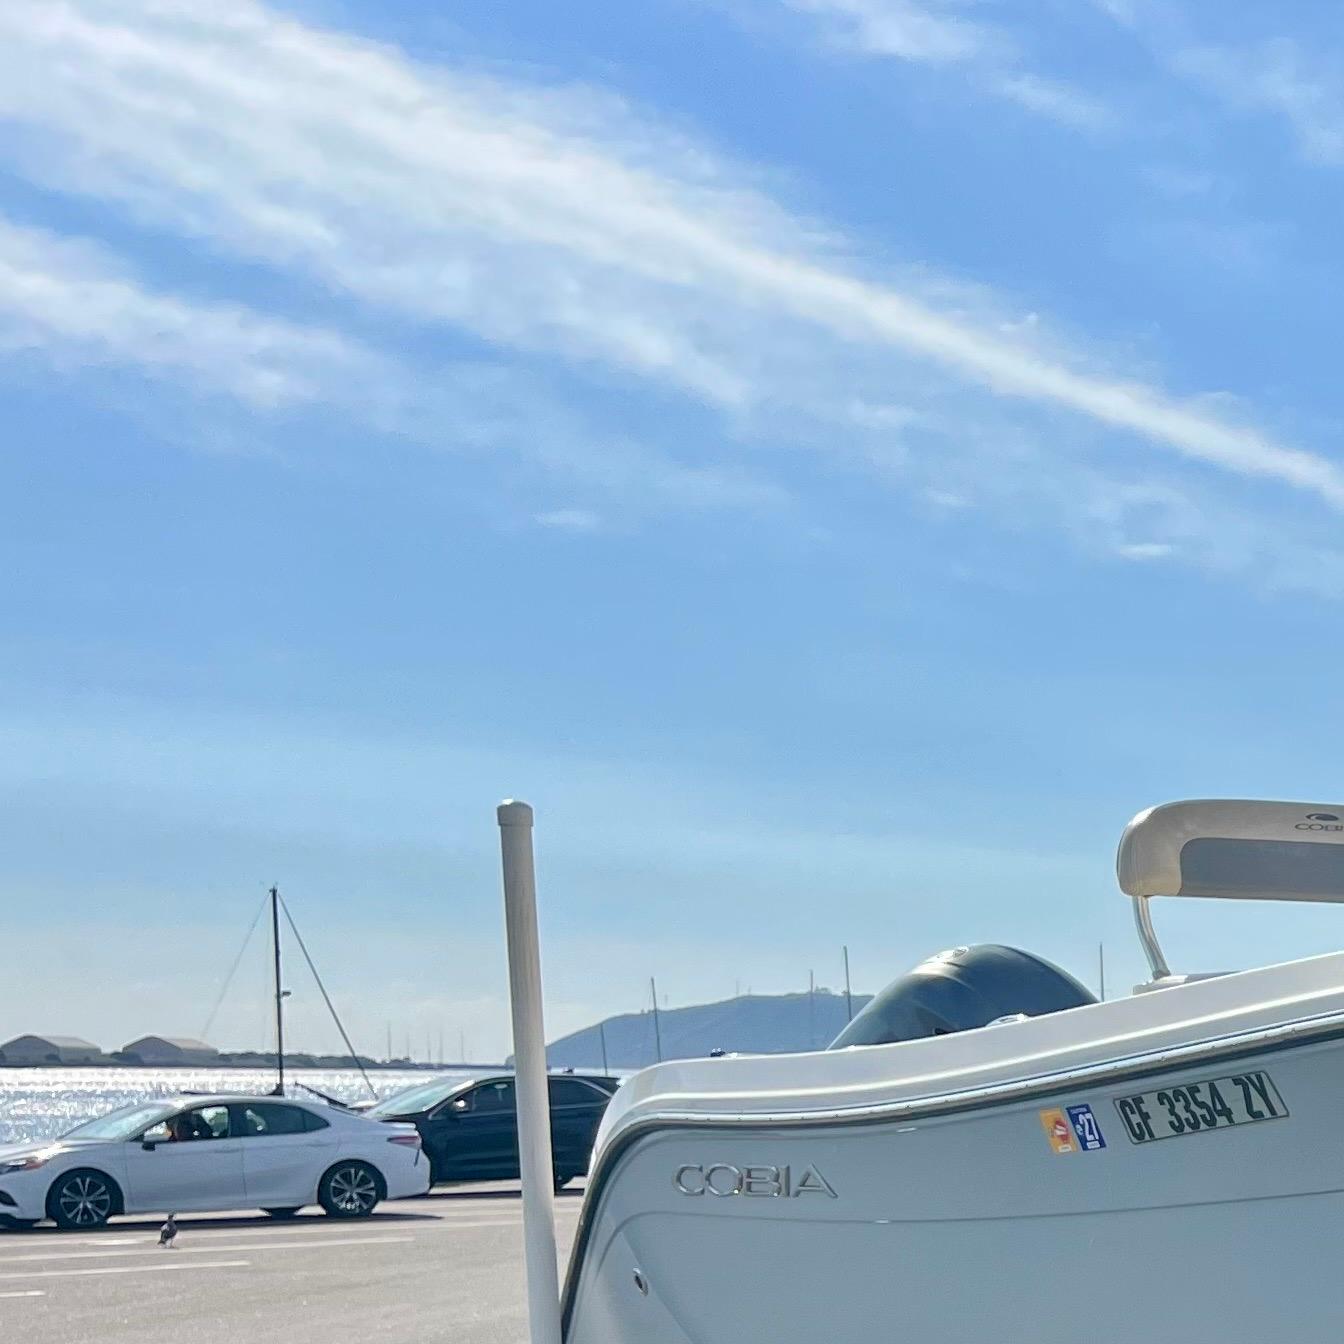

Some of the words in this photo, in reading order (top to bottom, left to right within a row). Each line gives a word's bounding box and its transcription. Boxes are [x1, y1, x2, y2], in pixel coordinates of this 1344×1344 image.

[1119, 1096, 1155, 1141] CF
[1157, 1081, 1235, 1134] 3354
[1231, 1073, 1279, 1120] ZY
[1078, 1112, 1099, 1142] 27
[672, 1161, 839, 1199] COBIA
